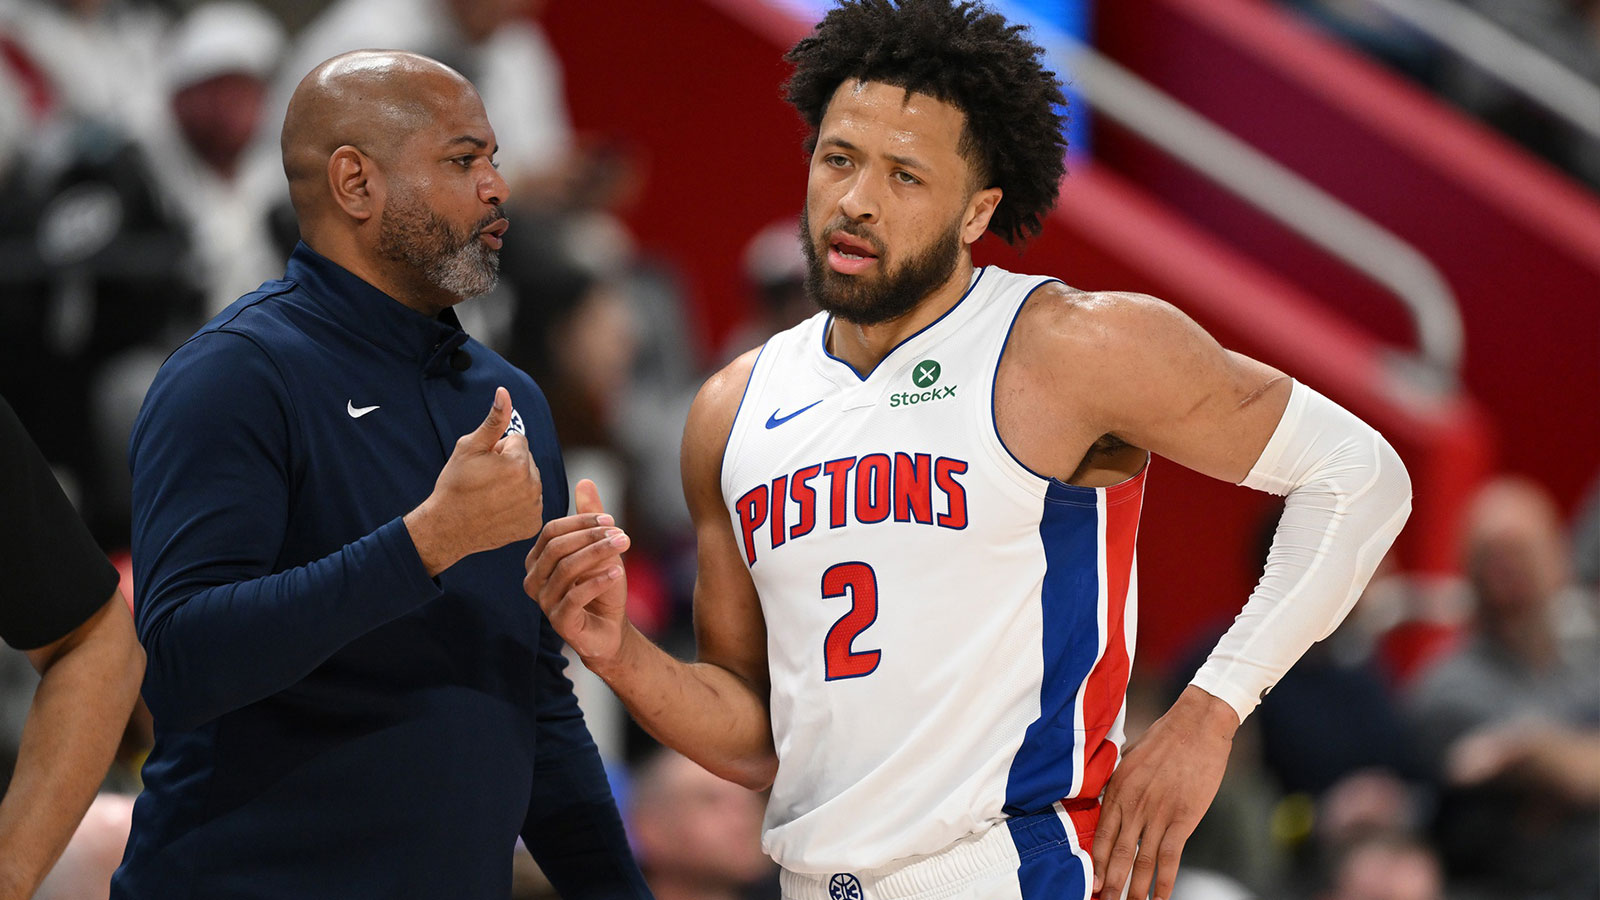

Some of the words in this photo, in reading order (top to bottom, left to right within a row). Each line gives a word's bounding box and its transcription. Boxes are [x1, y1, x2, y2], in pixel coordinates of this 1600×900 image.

[889, 385, 957, 407] StockX
[736, 452, 968, 568] PISTONS
[821, 561, 882, 681] 2
